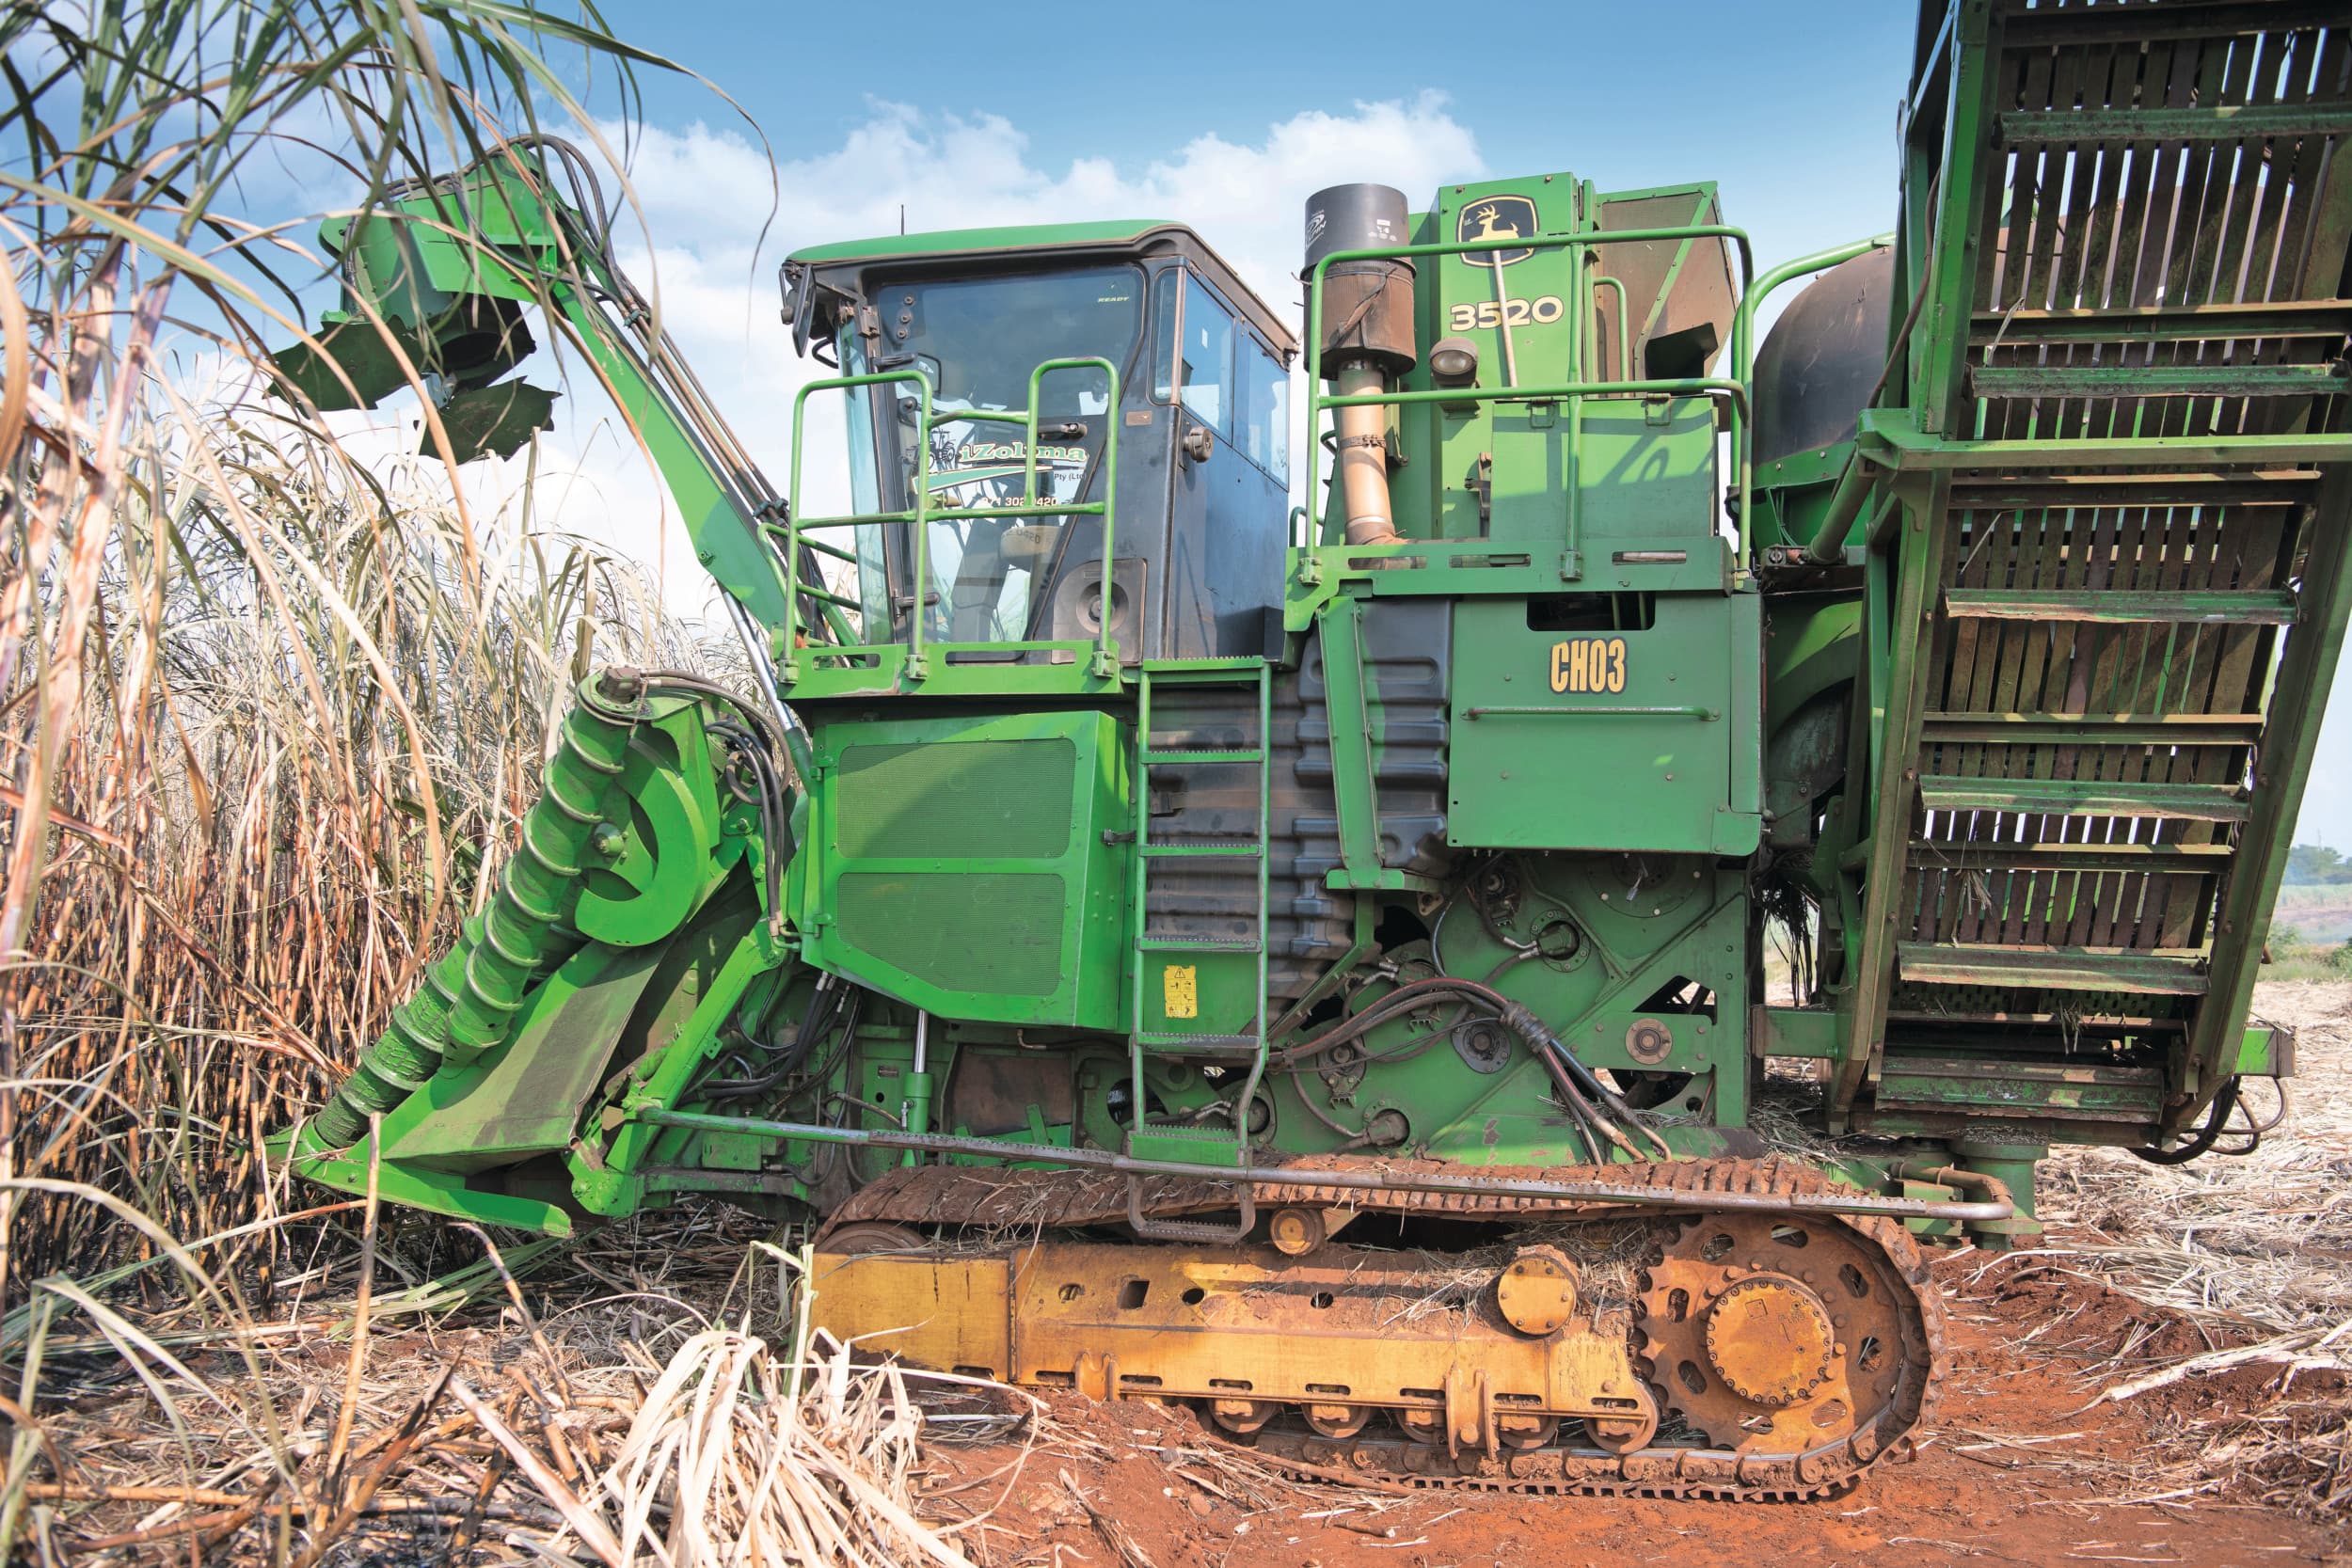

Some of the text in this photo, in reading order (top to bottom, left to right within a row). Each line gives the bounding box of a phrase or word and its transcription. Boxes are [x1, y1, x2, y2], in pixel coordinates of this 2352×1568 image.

[1450, 295, 1565, 332] 3520
[959, 441, 1088, 463] iZolma
[1054, 473, 1066, 483] Pty
[1034, 497, 1058, 507] 420
